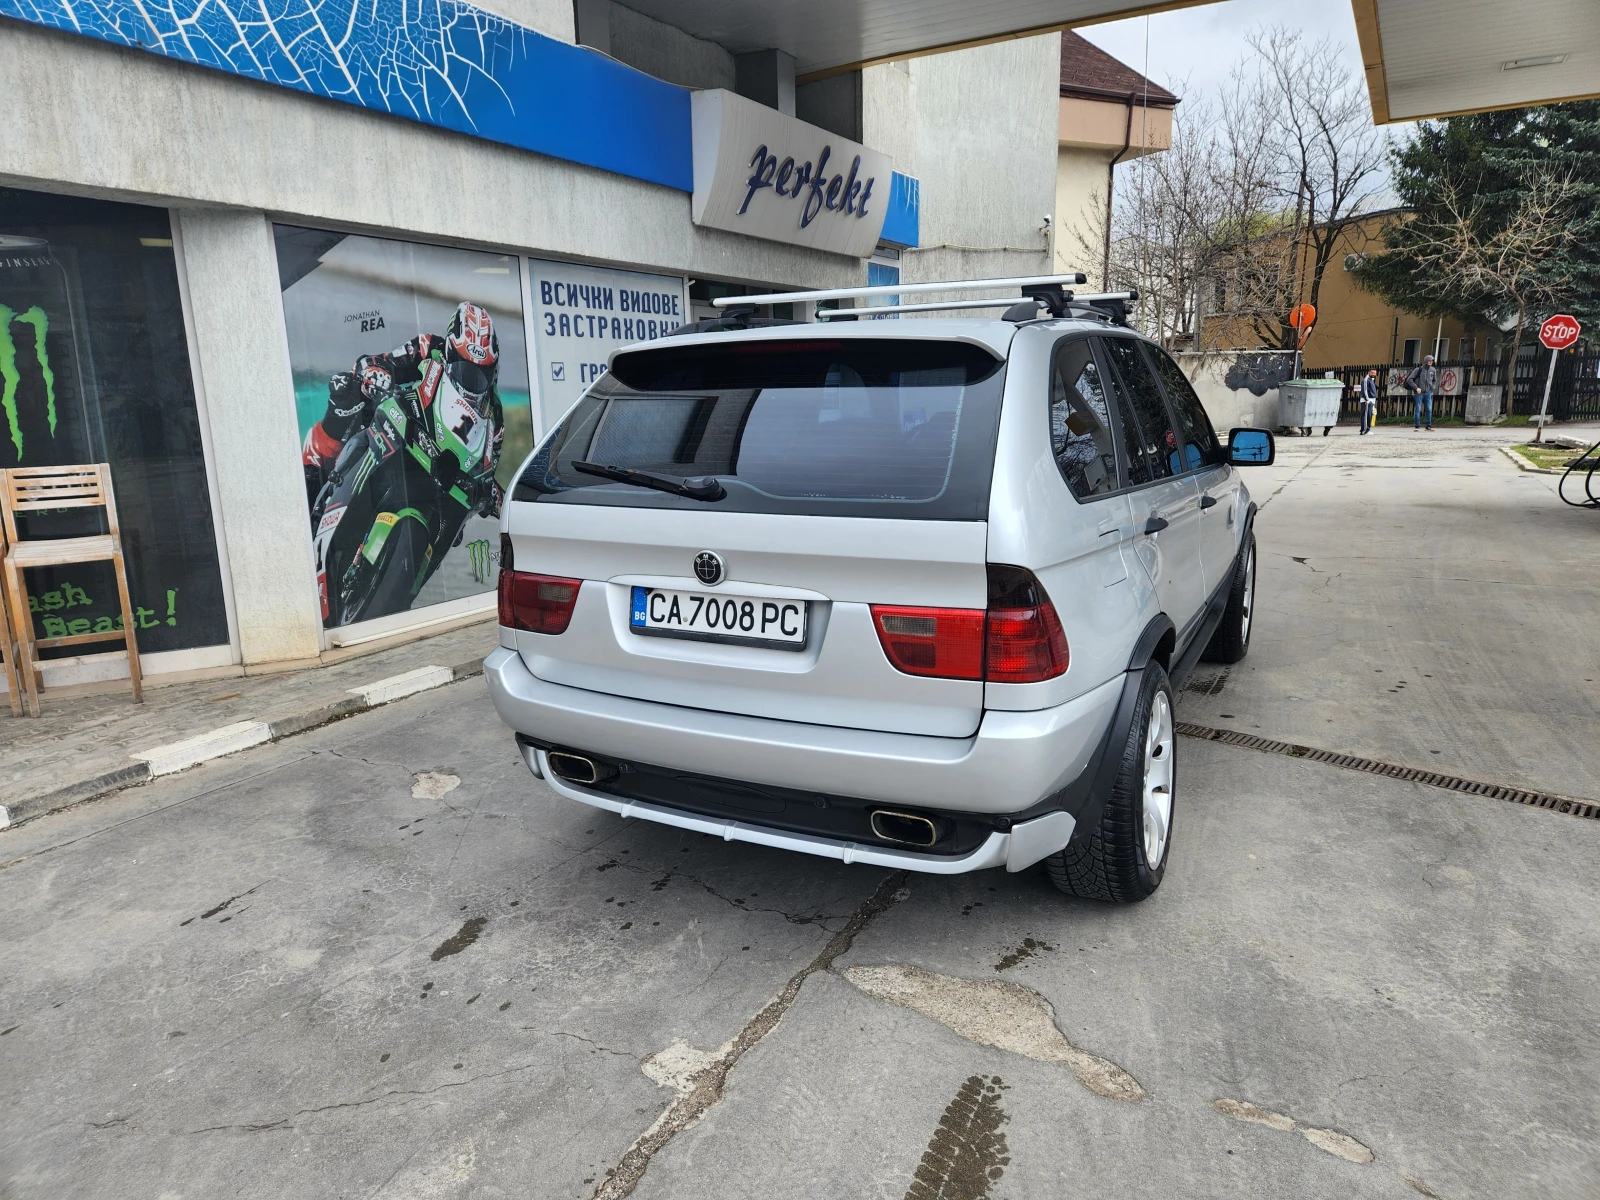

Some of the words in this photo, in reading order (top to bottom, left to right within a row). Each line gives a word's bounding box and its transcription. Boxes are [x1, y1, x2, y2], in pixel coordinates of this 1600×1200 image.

[736, 144, 875, 229] perfekt
[540, 280, 614, 311] ВСИЧКИ
[619, 289, 680, 316] ВИДОВЕ
[343, 309, 380, 323] JONATHAN
[360, 316, 386, 333] REA
[1543, 324, 1577, 339] STOP
[469, 345, 486, 358] Arai
[451, 413, 475, 446] 1
[634, 611, 646, 621] BG
